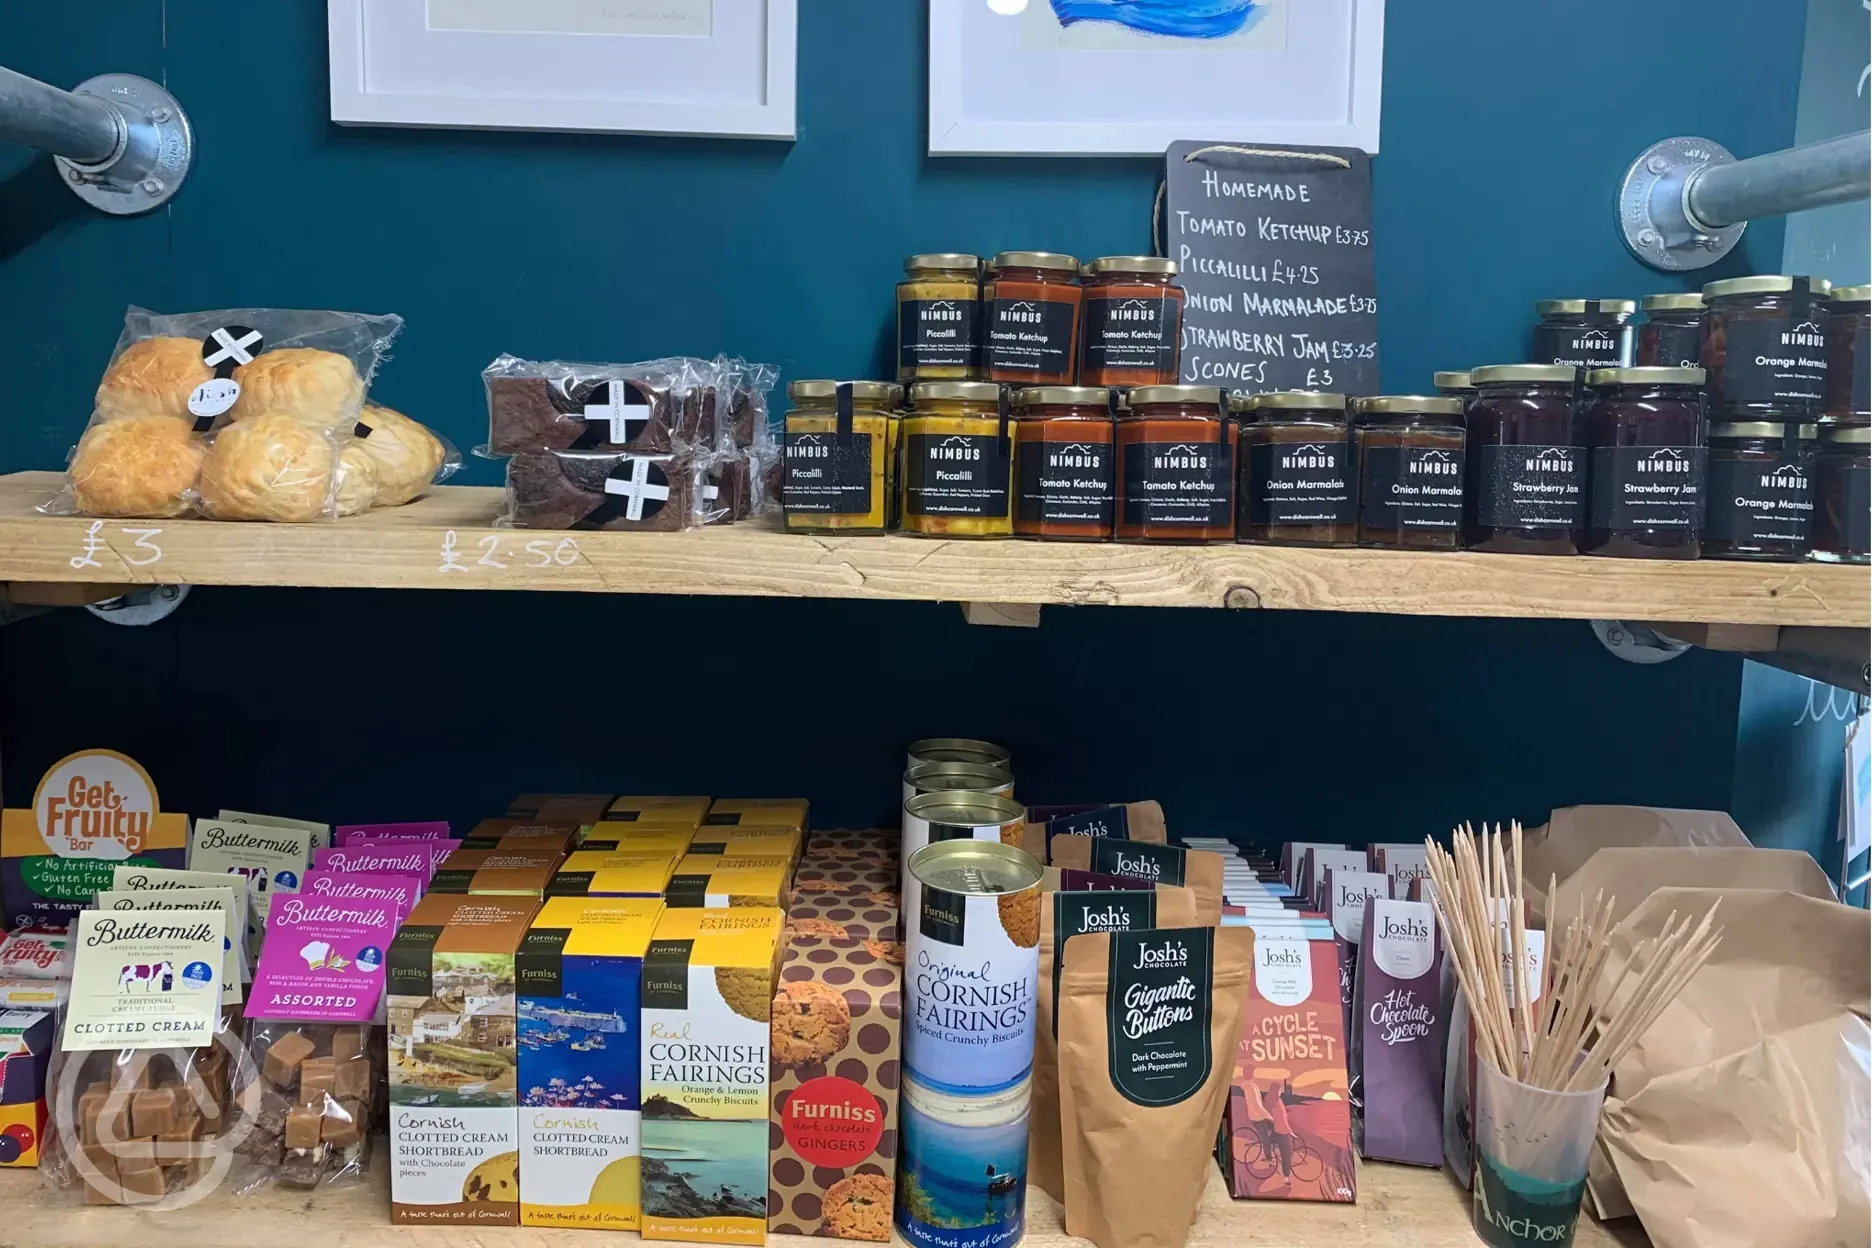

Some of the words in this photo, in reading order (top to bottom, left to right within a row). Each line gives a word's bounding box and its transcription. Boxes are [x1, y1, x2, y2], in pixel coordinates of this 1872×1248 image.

[1202, 169, 1310, 203] HOMEMADE
[1176, 210, 1246, 237] TOMATO
[1258, 217, 1332, 245] KETCHUP
[1180, 244, 1267, 282] PICCALILLI
[1243, 292, 1347, 318] MARMALADE
[921, 310, 962, 321] NIMBUS
[1000, 311, 1041, 323] NIMBUS
[1110, 309, 1155, 321] NIMBUS
[926, 329, 956, 339] Piccalilli
[990, 330, 1017, 341] Tomato
[1018, 331, 1048, 344] Ketchup
[1131, 329, 1163, 341] Ketchup
[1781, 332, 1824, 347] NIMBUS
[1291, 333, 1329, 363] JAM
[1572, 339, 1614, 350] NIMBUS
[1185, 356, 1267, 384] SCONES
[1306, 368, 1333, 387] £3
[787, 446, 828, 458] NIMBUS
[930, 447, 980, 460] NIMBUS
[1050, 455, 1100, 468] NIMBUS
[1155, 457, 1207, 469] NIMBUS
[1282, 456, 1335, 468] NIMBUS
[1526, 460, 1573, 472] NIMBUS
[1637, 460, 1689, 472] NIMBUS
[792, 468, 823, 478] Piccalilli
[1410, 462, 1457, 475] NIMBUS
[936, 471, 972, 481] Piccalilli
[1761, 475, 1808, 489] NIMBUS
[1039, 478, 1071, 488] Tomato
[1073, 479, 1107, 491] Ketchup
[1143, 480, 1177, 491] Tomato
[1179, 480, 1215, 492] Ketchup
[1266, 480, 1294, 490] Onion
[1392, 485, 1419, 495] Onion
[1513, 482, 1564, 495] Strawberry
[1624, 484, 1679, 495] Strawberry
[1735, 497, 1776, 510] Orange
[69, 519, 162, 570] £3
[67, 776, 124, 809] Get
[46, 797, 149, 855] Fruity
[69, 837, 94, 852] Bar
[45, 860, 59, 871] No
[63, 860, 116, 872] Artificia
[1111, 851, 1160, 875] Josh's
[41, 872, 80, 884] Gluten
[84, 872, 109, 884] Free
[1120, 871, 1160, 881] CHOCOLATE
[57, 886, 71, 896] No
[32, 902, 49, 910] THE
[53, 903, 82, 911] TASTY
[924, 904, 960, 924] Furniss
[1078, 906, 1130, 933] Josh's
[700, 922, 771, 930] FAIRINGS
[1089, 925, 1130, 933] CHOCOLATE
[1379, 916, 1428, 940] Josh's
[399, 931, 435, 940] Furniss
[528, 934, 563, 942] Furniss
[1388, 934, 1427, 943] CHOCOLATE
[13, 939, 44, 950] Get
[652, 946, 687, 954] Furniss
[1133, 940, 1188, 970] Josh's
[1263, 948, 1302, 967] Josh's
[918, 949, 991, 982] Original
[1144, 961, 1187, 969] CHOCOLATE
[392, 967, 427, 978] Furniss
[521, 969, 557, 979] Furniss
[647, 980, 683, 991] Furniss
[917, 973, 1028, 1008] CORNISH
[270, 994, 357, 1008] ASSORTED
[1124, 976, 1196, 1013] Gigantic
[1384, 989, 1416, 1008] Hot
[916, 996, 1027, 1032] FAIRINGS
[1370, 1002, 1435, 1025] Chocolate
[74, 1022, 146, 1034] CLOTTED
[152, 1021, 205, 1032] CREAM
[1123, 1005, 1193, 1040] Buttons
[1252, 1024, 1260, 1035] A
[1261, 1011, 1319, 1036] CYCLE
[650, 1022, 692, 1042] Real
[915, 1019, 942, 1040] Spiced
[944, 1029, 989, 1047] Crunchy
[992, 1026, 1024, 1044] Biscuits
[1381, 1021, 1428, 1046] Spoon
[650, 1043, 765, 1064] CORNISH
[1251, 1034, 1337, 1061] SUNSET
[1132, 1053, 1149, 1062] Dark
[1150, 1050, 1187, 1060] Chocolate
[650, 1063, 765, 1084] FAIRINGS
[1132, 1064, 1147, 1073] with
[1147, 1061, 1187, 1072] Peppermint
[681, 1085, 715, 1096] Orange
[717, 1085, 724, 1094] &
[727, 1085, 759, 1095] Lemon
[683, 1095, 721, 1106] Crunchy
[724, 1096, 759, 1106] Biscuits
[792, 1099, 877, 1123] Furniss
[398, 1112, 466, 1131] Cornish
[533, 1113, 599, 1132] Cornish
[793, 1120, 821, 1133] dark
[823, 1122, 873, 1135] chocolate
[399, 1132, 459, 1143] CLOTTED
[462, 1132, 508, 1143] CREAM
[533, 1133, 587, 1143] CLOTTED
[589, 1134, 629, 1145] CREAM
[798, 1136, 866, 1151] GINGERS
[399, 1146, 484, 1157] SHORTBREAD
[533, 1146, 608, 1157] SHORTBREAD
[399, 1159, 418, 1168] with
[420, 1159, 466, 1168] Chocolate
[399, 1169, 426, 1178] pieces
[400, 1211, 407, 1219] A
[409, 1211, 428, 1219] taste
[430, 1209, 450, 1219] that's
[453, 1211, 464, 1219] out
[467, 1208, 476, 1220] of
[478, 1209, 512, 1219] Cornwall
